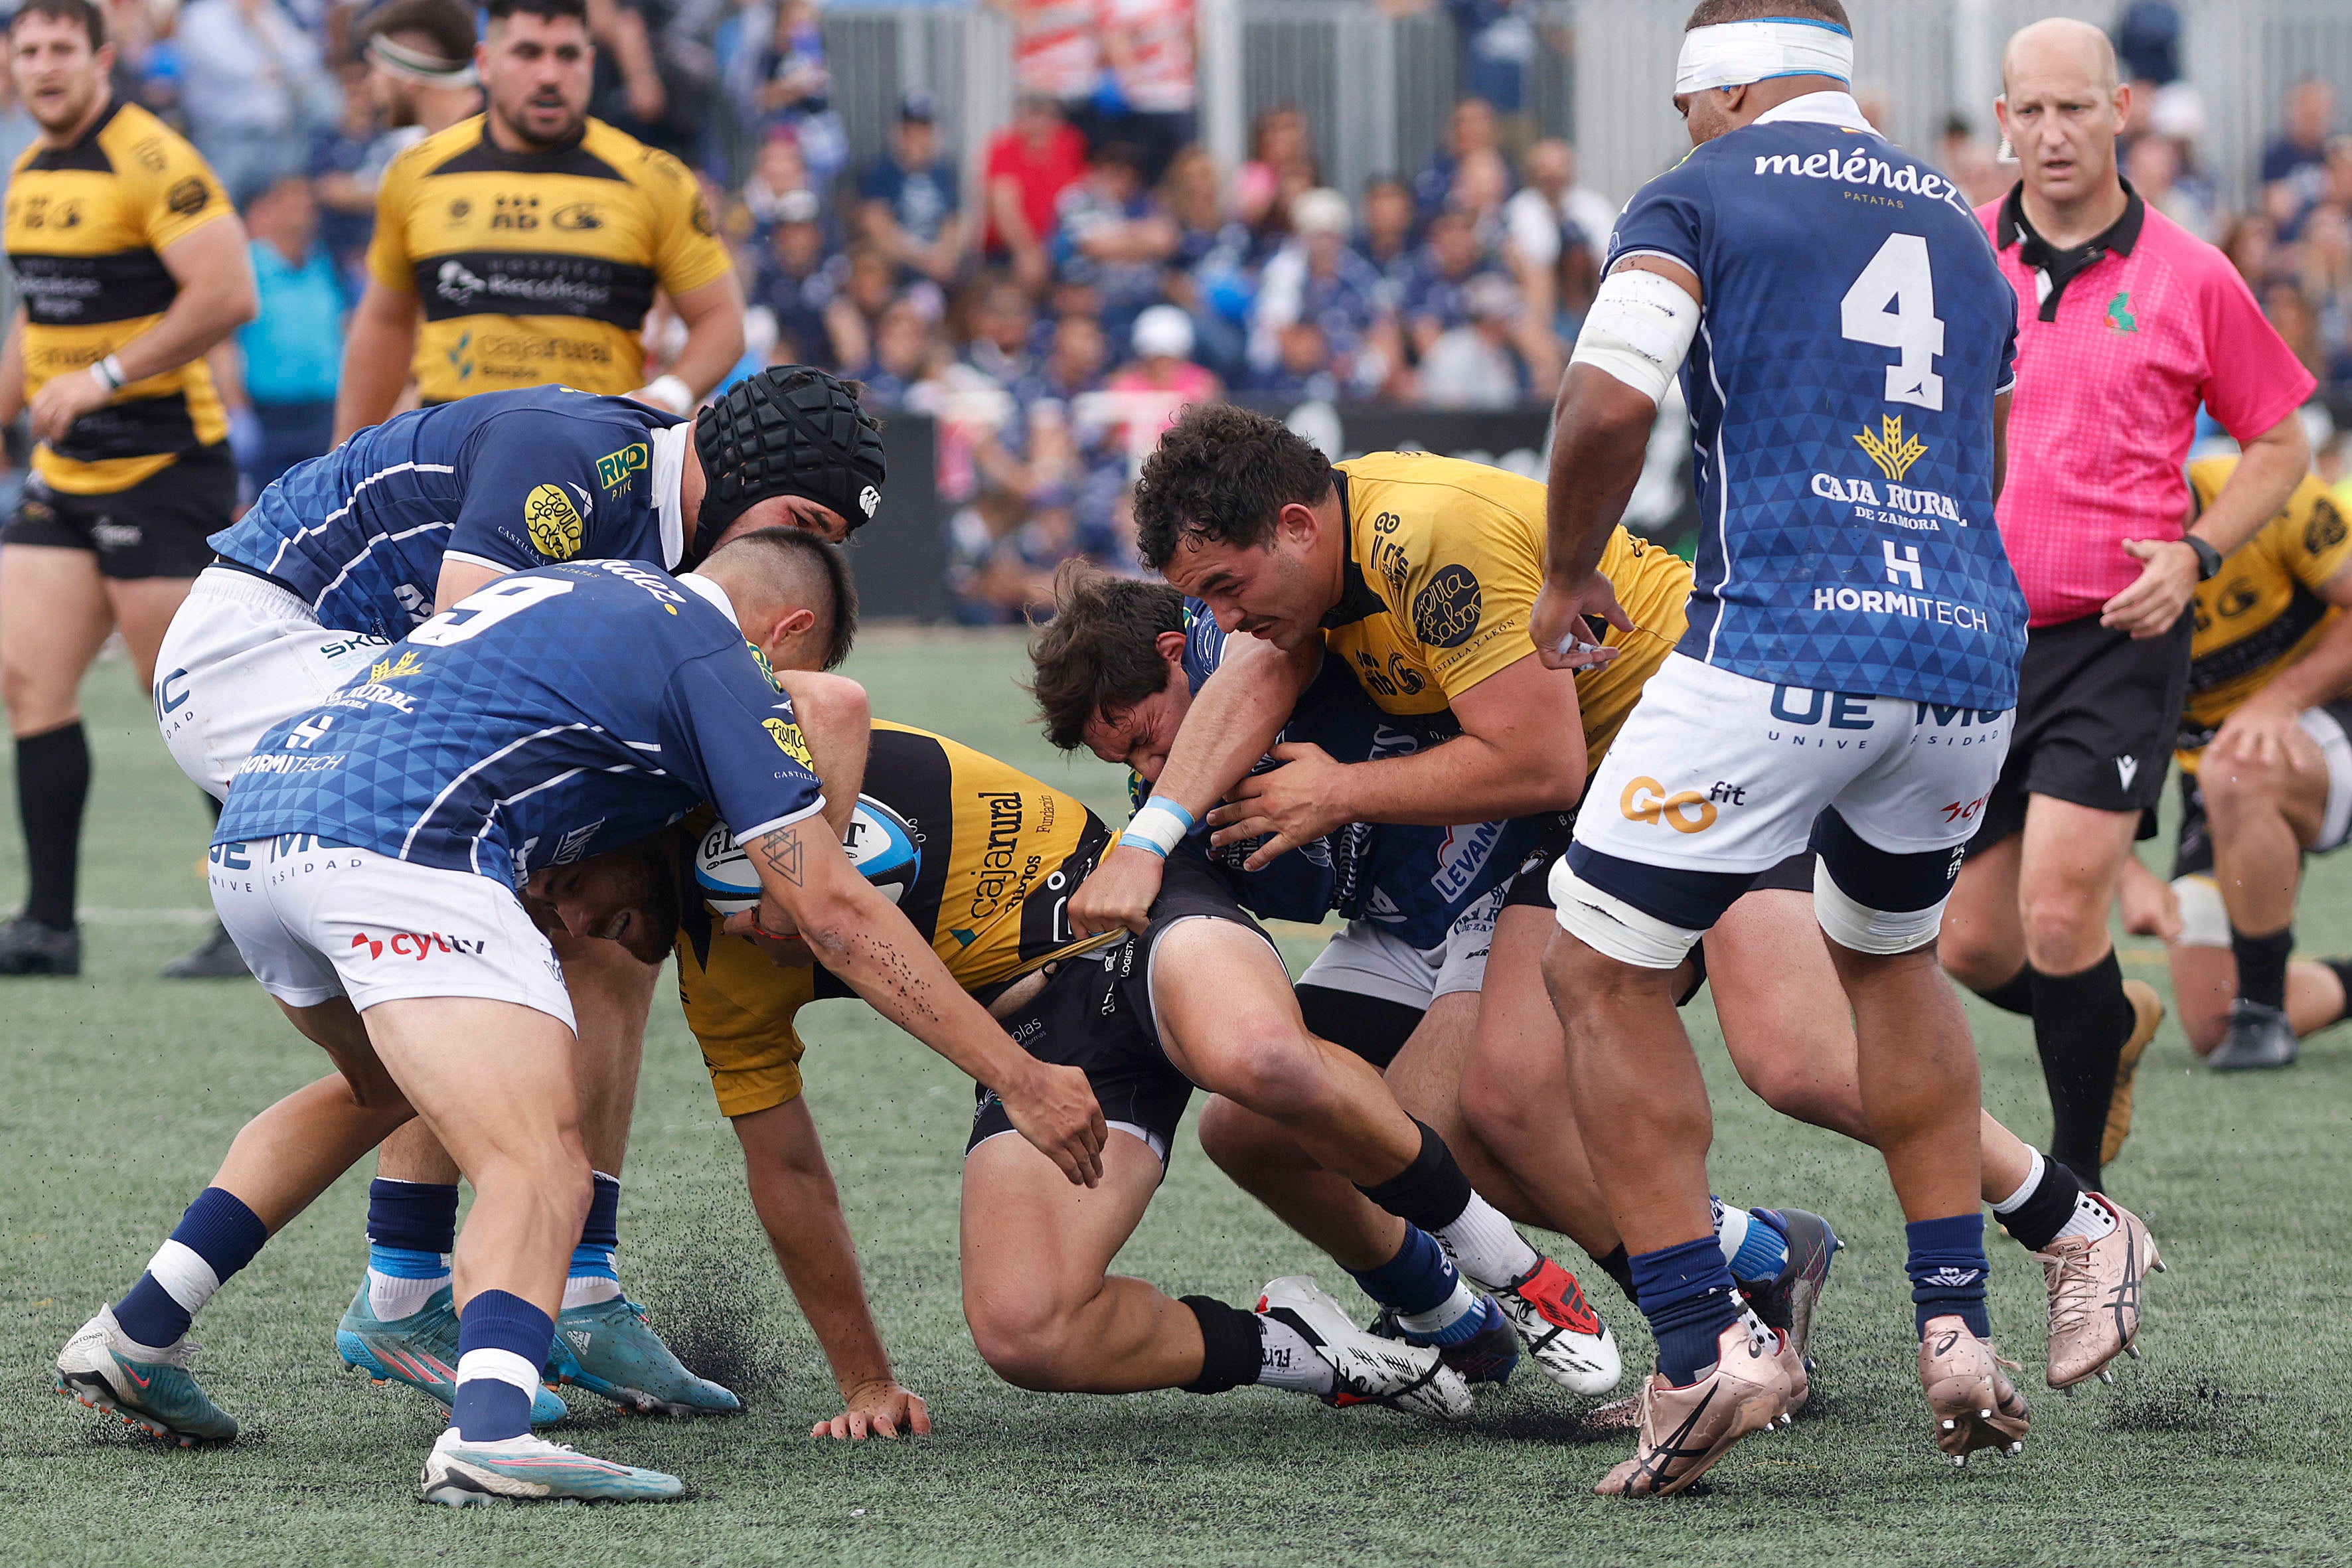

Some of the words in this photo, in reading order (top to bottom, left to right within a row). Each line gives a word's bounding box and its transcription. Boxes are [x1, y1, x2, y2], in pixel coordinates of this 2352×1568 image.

[1755, 147, 1967, 216] meléndez
[1843, 191, 1905, 209] PATATAS
[1840, 232, 1945, 411] 4
[598, 445, 645, 488] RKD
[1811, 473, 1880, 506] CAJA
[1886, 483, 1968, 528] RURAL
[1854, 506, 1875, 520] DE
[1878, 511, 1940, 531] ZAMORA
[498, 526, 540, 561] CASTILLA
[407, 576, 575, 648] 9
[1484, 619, 1516, 641] LEÓN
[1814, 588, 1988, 633] HORMITECH
[236, 754, 347, 775] HORMITECH
[1036, 795, 1055, 833] Fundación
[1710, 781, 1746, 807] fit
[971, 791, 1023, 919] cajarural
